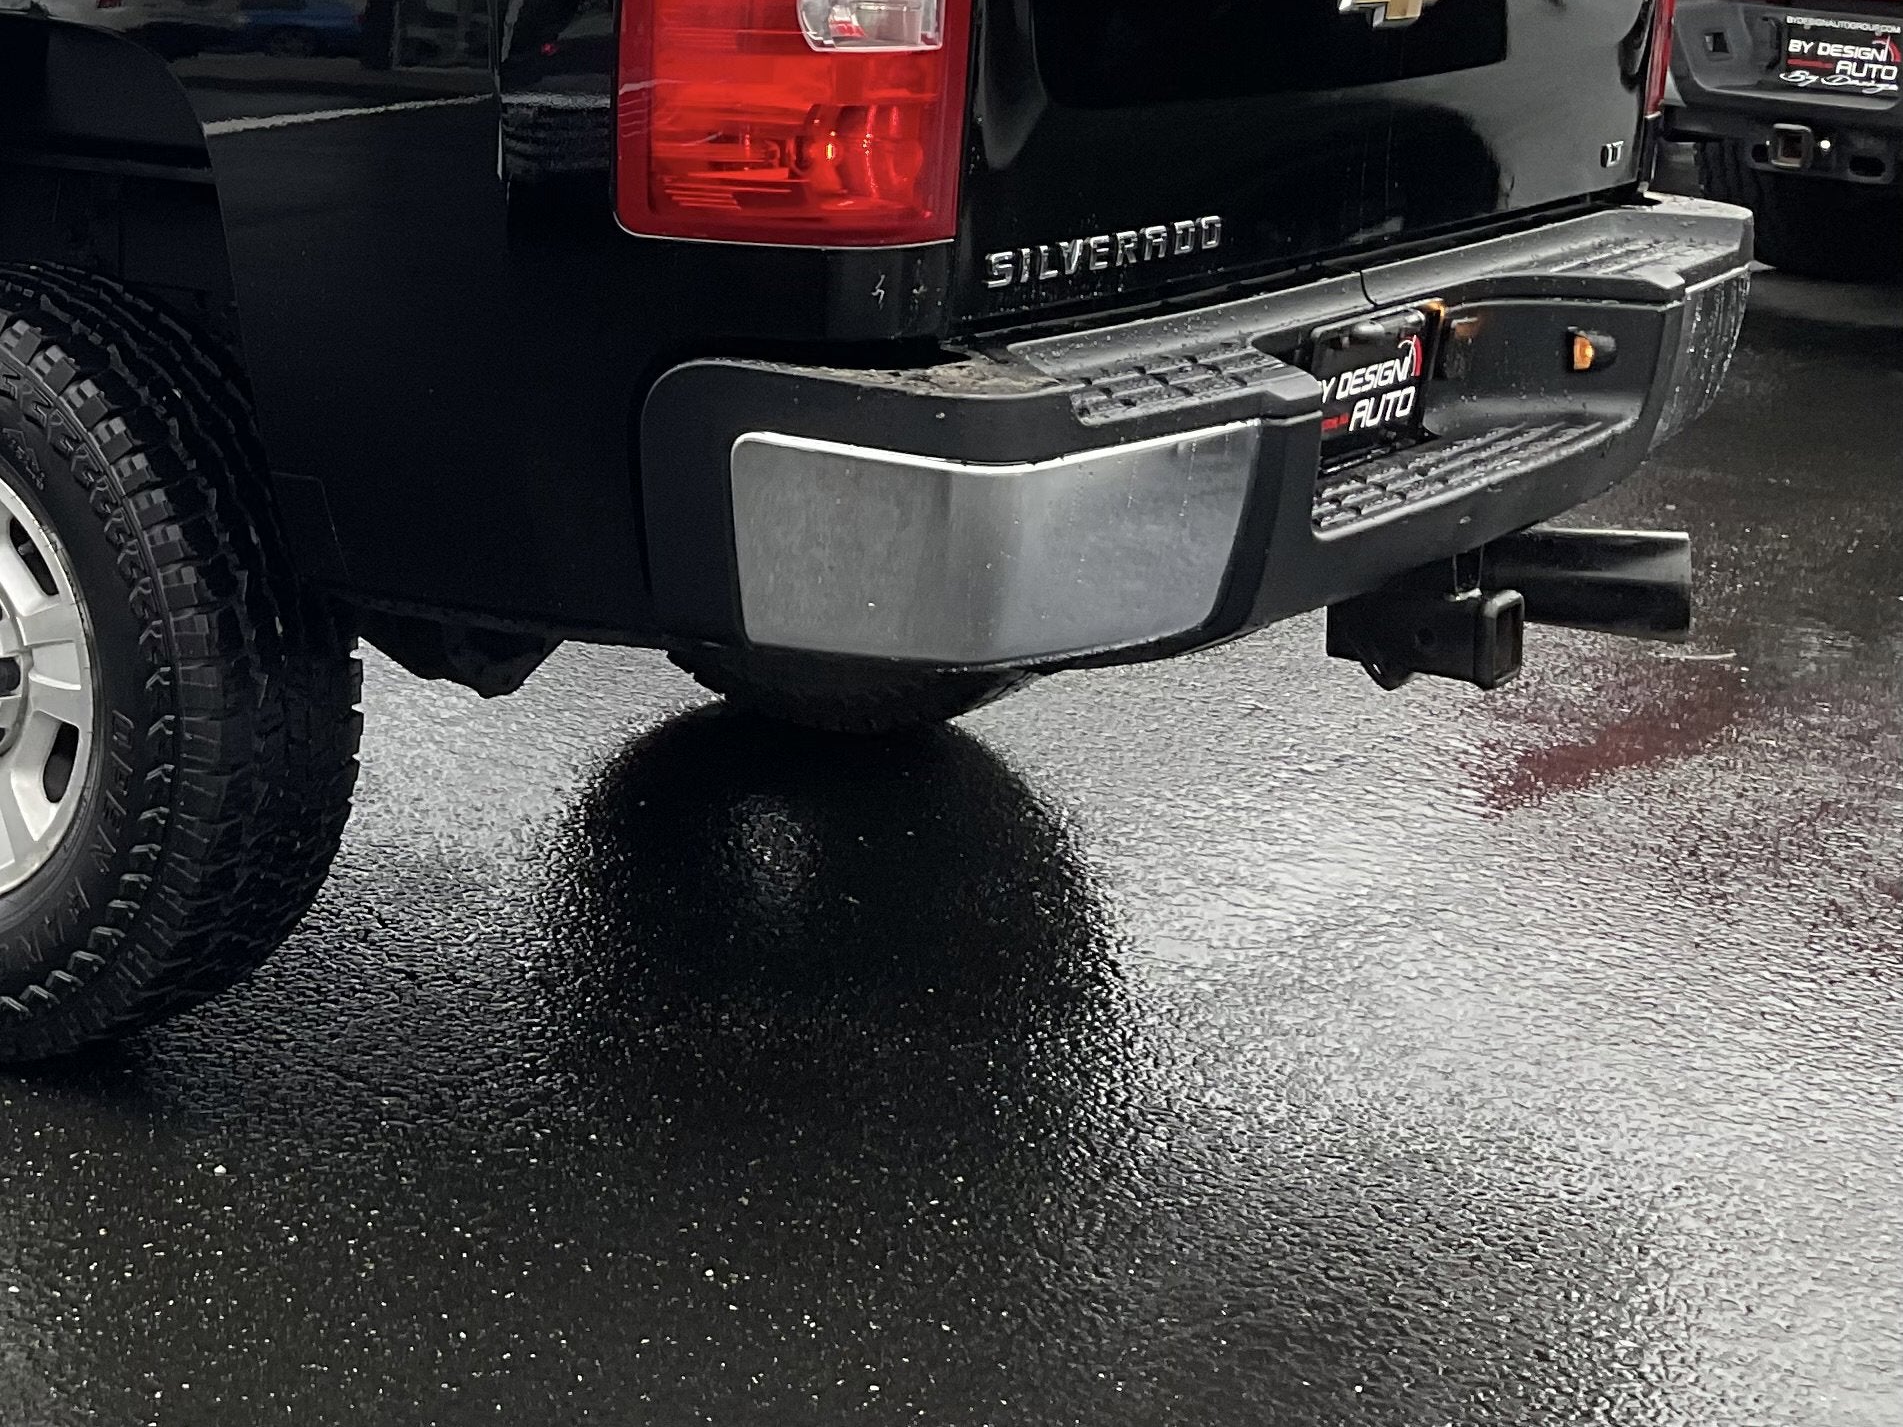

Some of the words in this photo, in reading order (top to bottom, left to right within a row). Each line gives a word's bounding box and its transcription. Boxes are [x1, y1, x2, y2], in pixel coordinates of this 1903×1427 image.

[1787, 38, 1814, 54] BY
[1817, 41, 1888, 62] DESIGN
[1835, 60, 1899, 81] AUTO
[1603, 140, 1625, 168] LT
[983, 214, 1223, 289] SILVERADO
[1318, 377, 1336, 403] Y
[1336, 357, 1411, 400] DESIGN
[1349, 386, 1415, 431] AUTO
